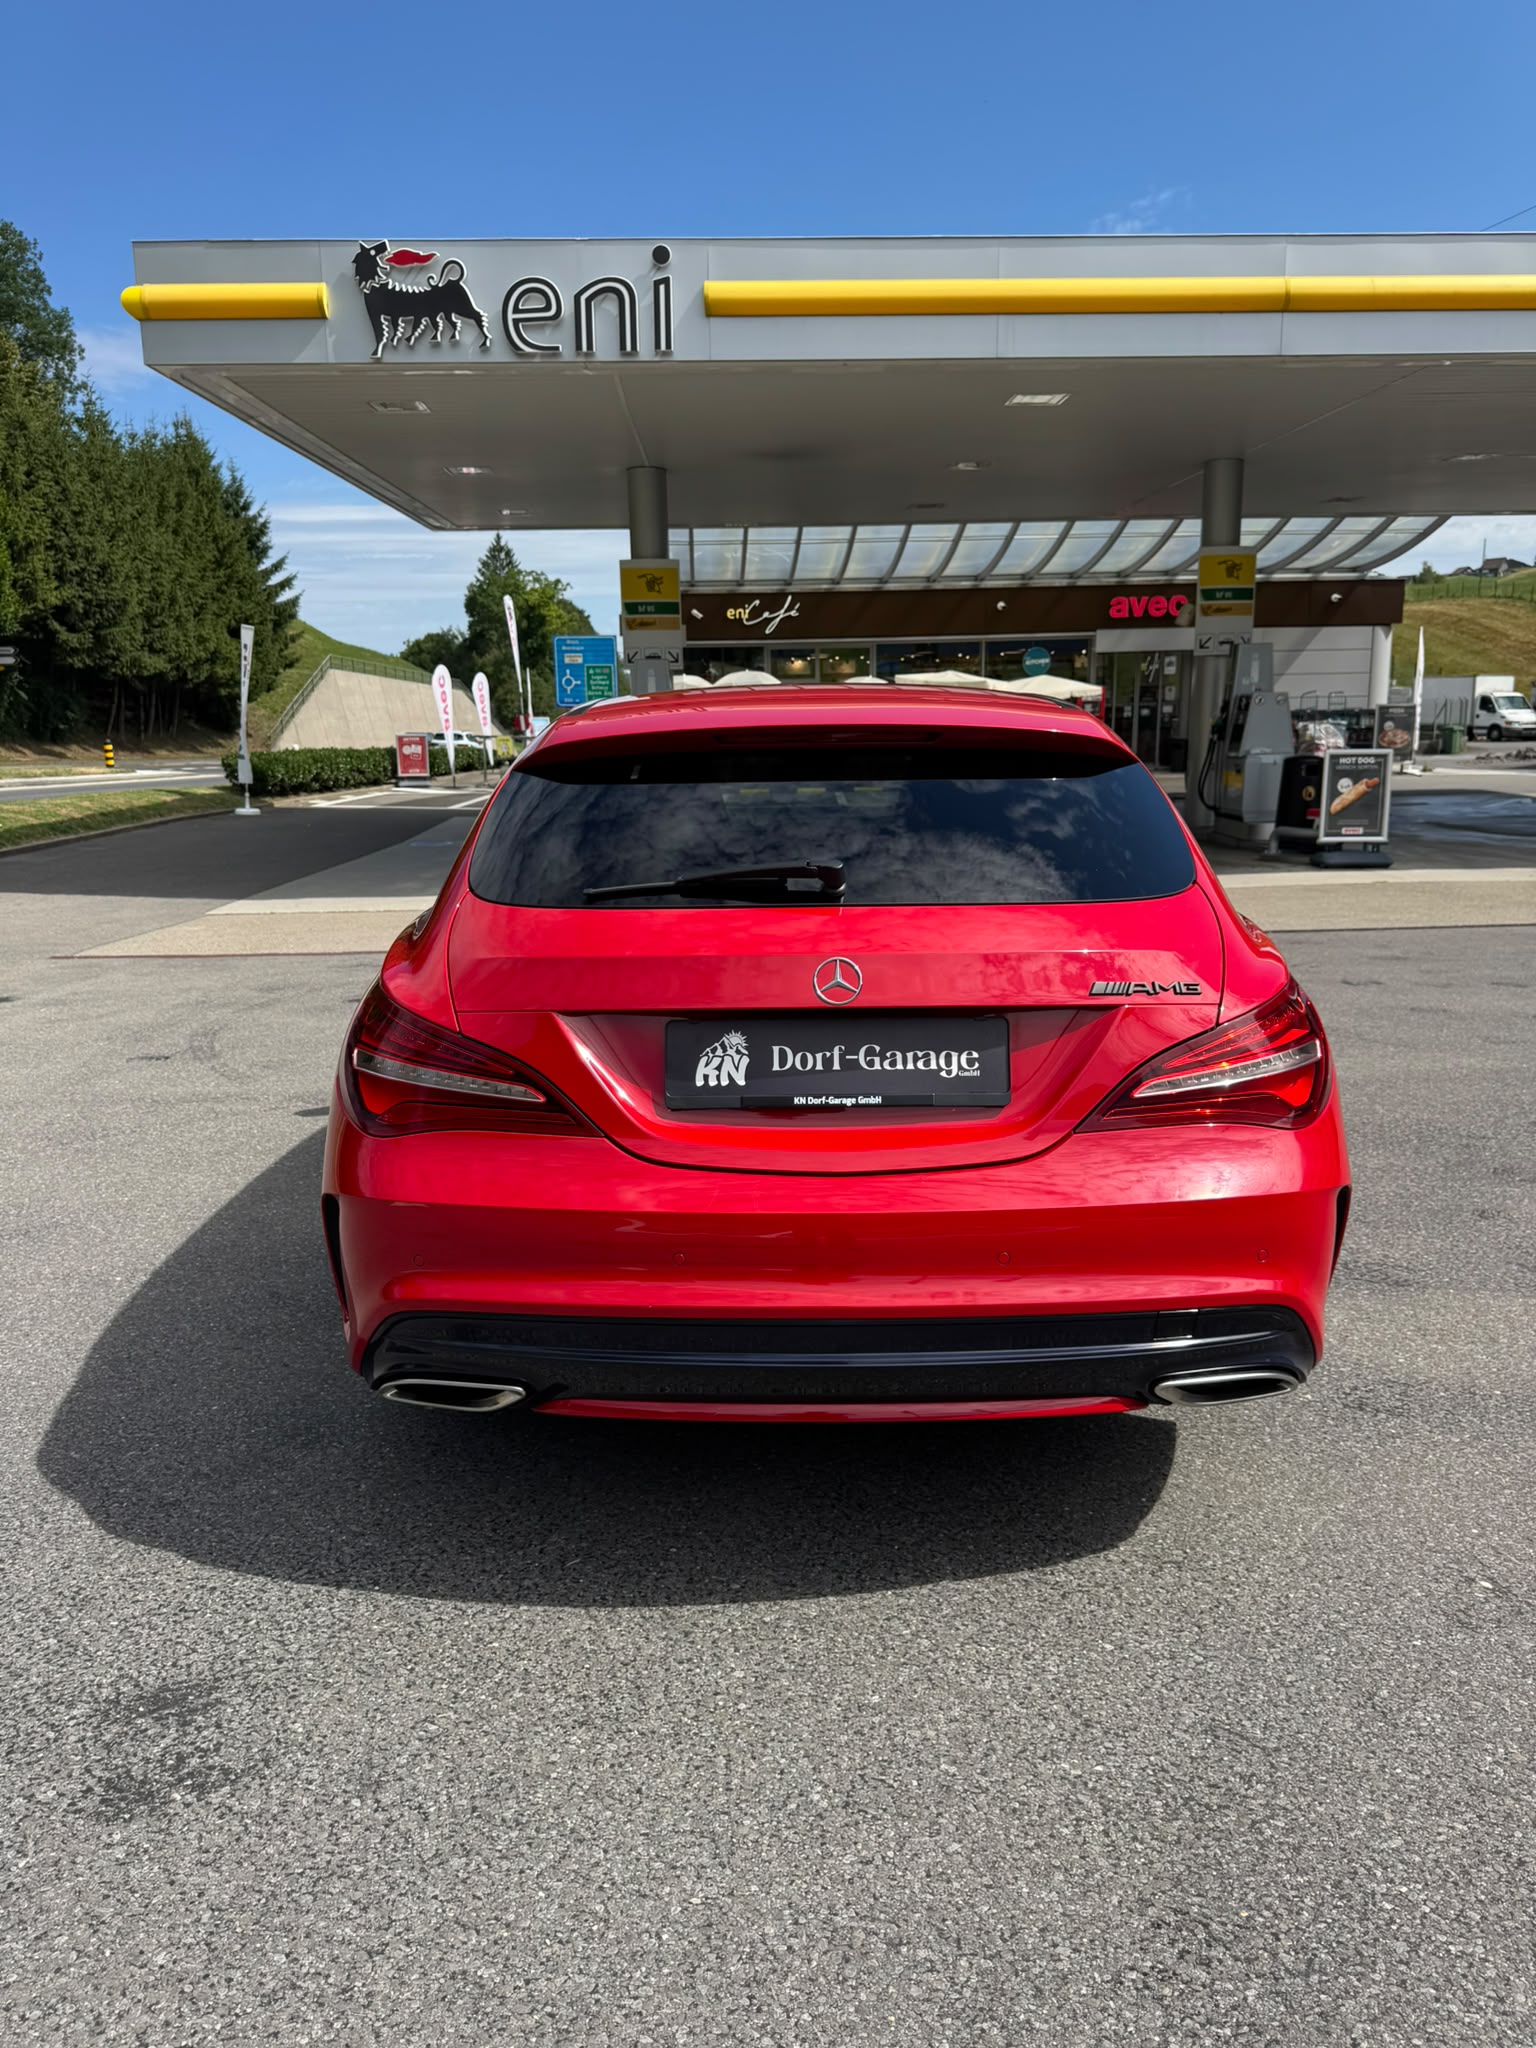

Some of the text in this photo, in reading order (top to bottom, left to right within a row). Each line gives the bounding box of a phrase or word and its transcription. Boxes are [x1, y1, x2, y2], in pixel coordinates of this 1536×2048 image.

[501, 243, 672, 352] eni
[1109, 595, 1188, 618] avec
[1339, 756, 1375, 764] HOT DOG
[1125, 981, 1202, 997] AMG
[695, 1044, 980, 1087] KN Dorf-Garage
[794, 1096, 882, 1106] KN Dorf-Garage GmbH
